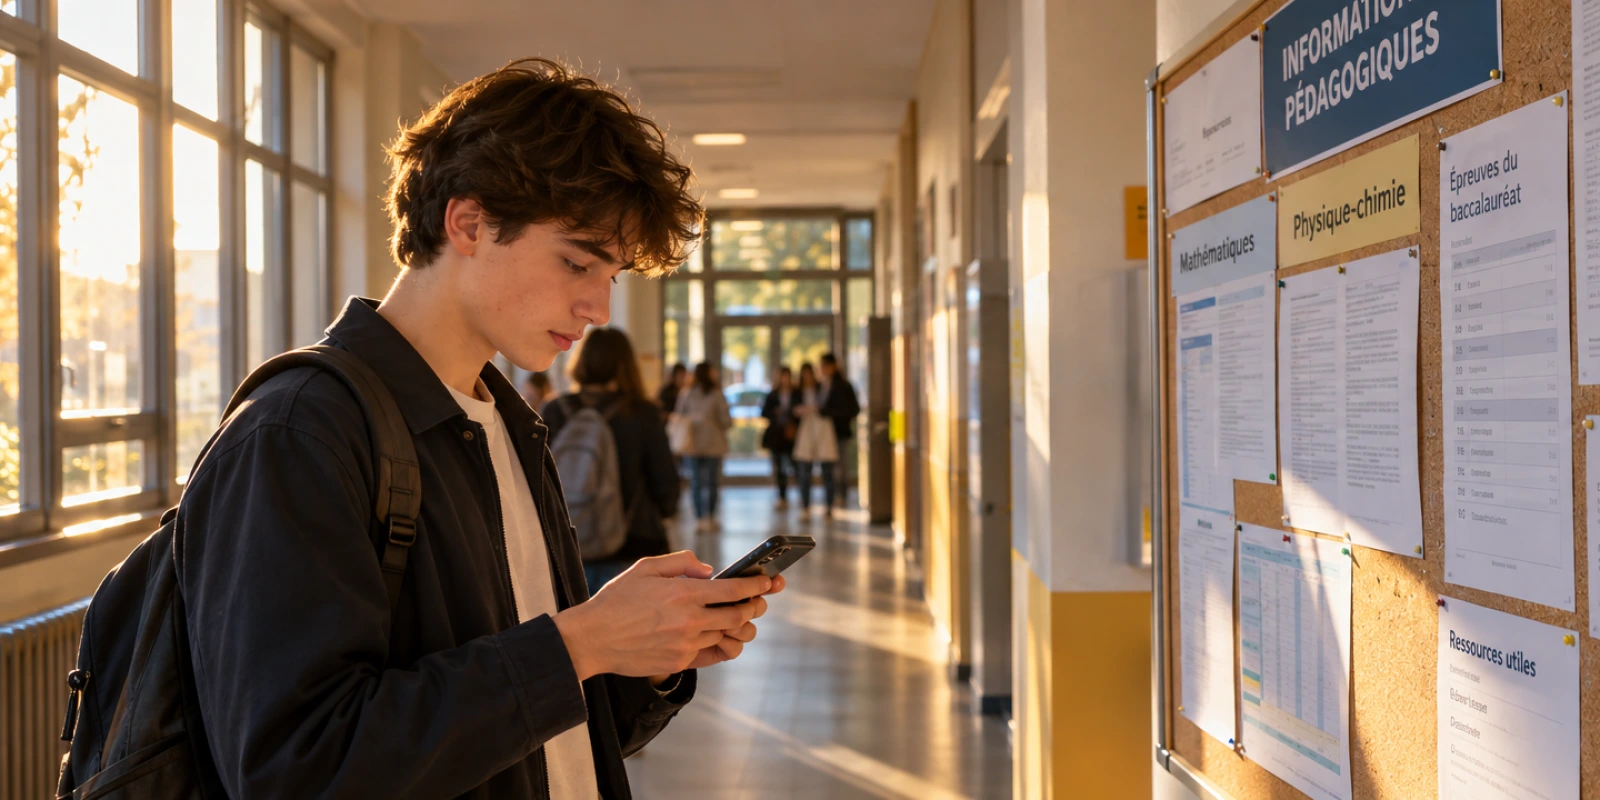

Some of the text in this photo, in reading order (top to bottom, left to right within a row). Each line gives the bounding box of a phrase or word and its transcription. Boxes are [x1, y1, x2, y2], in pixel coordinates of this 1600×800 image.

[1282, 0, 1411, 82] INFORMATI
[1285, 10, 1440, 131] PÉDAGOGIQUES
[1450, 149, 1518, 196] Épreuves du
[1293, 178, 1406, 242] Physique-chimie
[1450, 183, 1522, 223] baccalauréat
[1180, 233, 1255, 274] Mathématiques
[1449, 629, 1503, 666] Ressources
[1505, 650, 1537, 678] utiles
